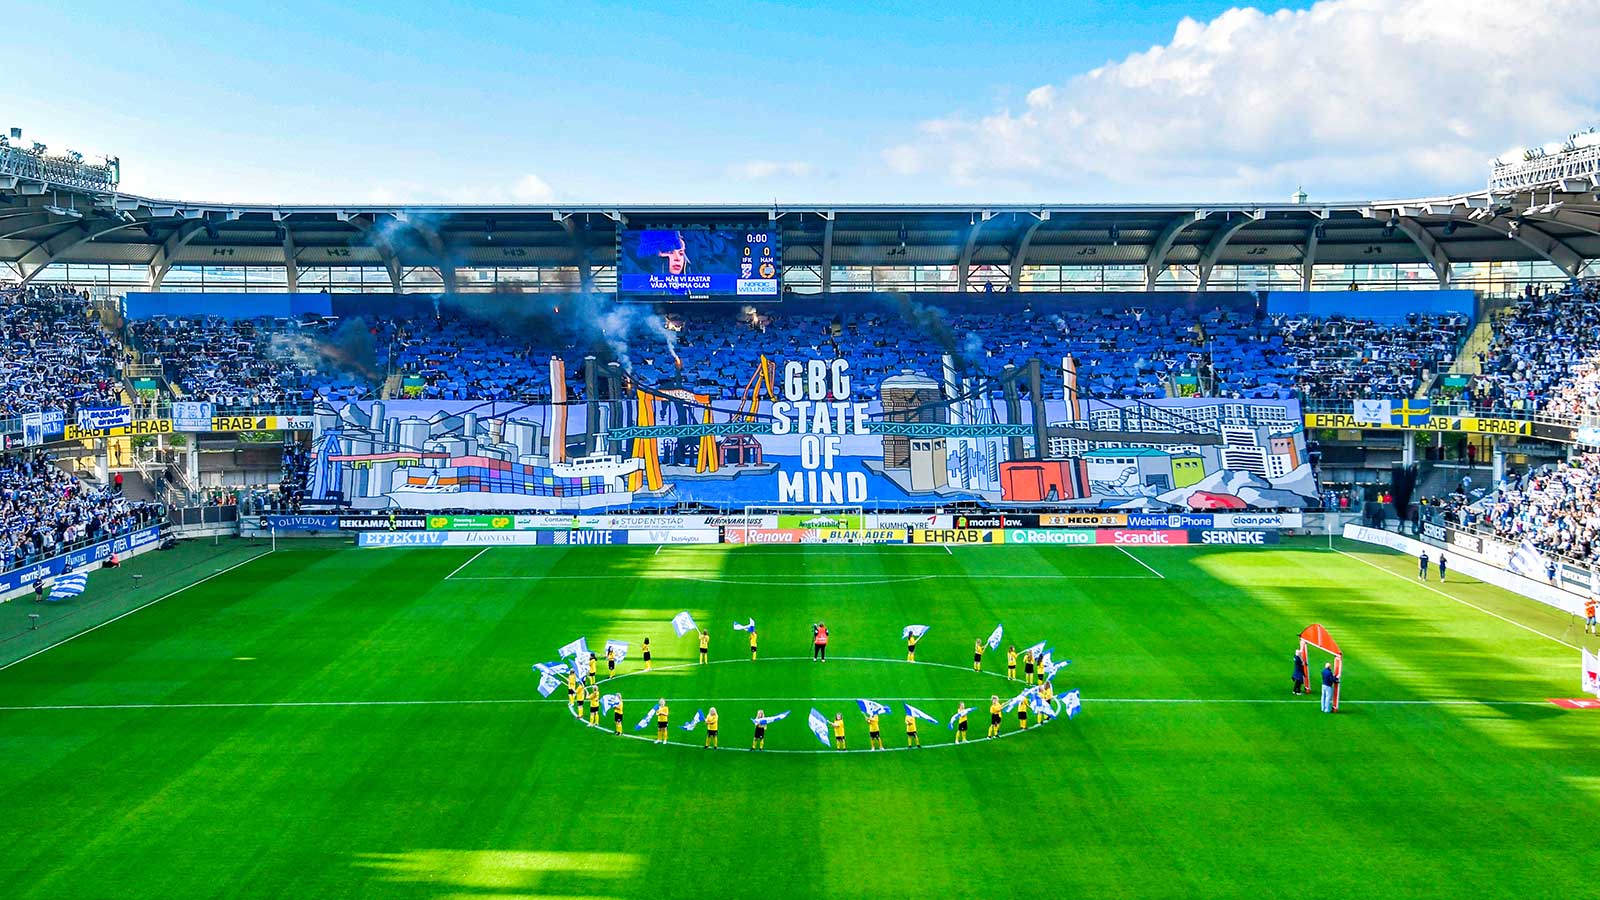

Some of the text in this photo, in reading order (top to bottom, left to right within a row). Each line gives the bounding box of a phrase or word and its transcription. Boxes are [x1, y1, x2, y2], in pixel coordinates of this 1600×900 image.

[747, 233, 767, 243] 0:00
[744, 247, 750, 256] 0
[764, 247, 770, 256] 0
[784, 358, 850, 402] GBG
[211, 417, 252, 431] HRAB
[771, 401, 871, 435] STATE
[1477, 419, 1517, 434] EHRAB
[800, 434, 842, 470] OF
[777, 470, 867, 504] MIND
[279, 517, 326, 527] OLIVEDAL
[340, 519, 425, 528] REKLAMFARIKEN
[430, 517, 448, 528] GP
[491, 517, 509, 528] GP
[969, 517, 1000, 526] morris
[1129, 516, 1167, 526] Weblink
[1181, 517, 1211, 526] Phone
[1233, 517, 1281, 526] clean park
[569, 531, 612, 544] ENVITE
[748, 530, 793, 542] Renova
[924, 530, 978, 542] EHRAB
[1028, 530, 1089, 543] Rekomo
[1114, 531, 1168, 544] Scandic
[1201, 531, 1265, 544] SERNEKE
